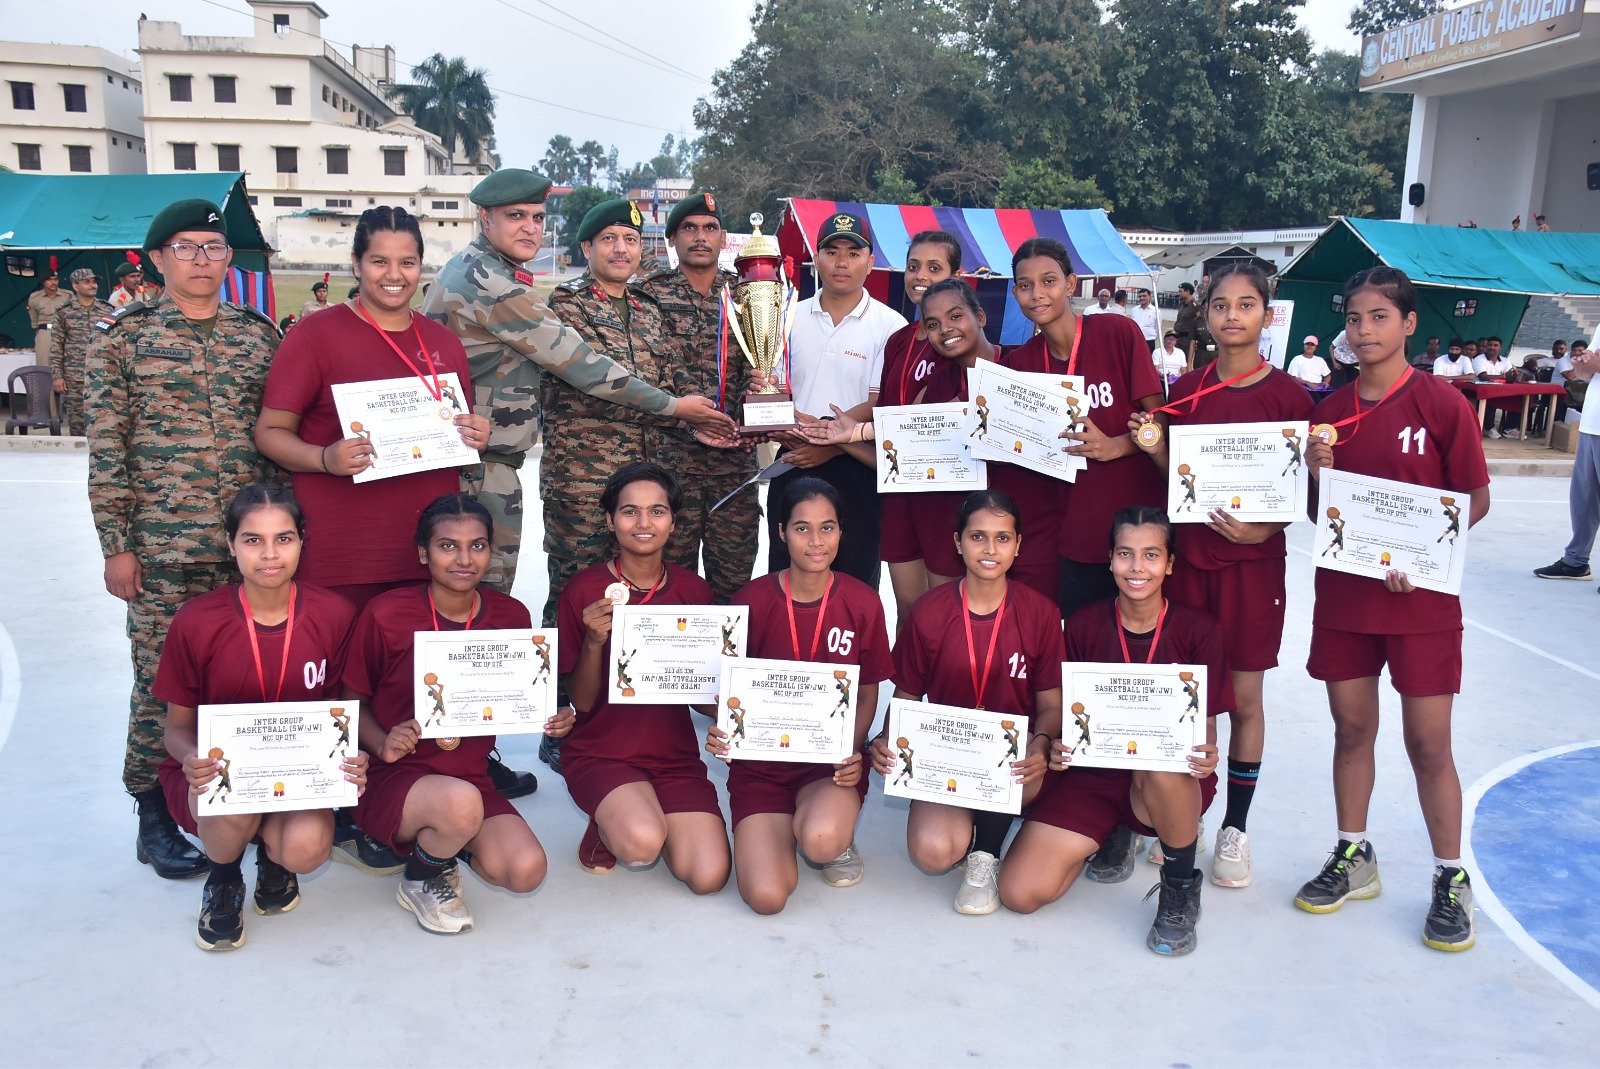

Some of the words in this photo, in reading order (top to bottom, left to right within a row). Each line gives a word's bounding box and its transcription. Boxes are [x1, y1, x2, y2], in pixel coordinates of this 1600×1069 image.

[1380, 17, 1436, 66] CENTRAL
[1440, 1, 1494, 48] PUBLIC
[1407, 59, 1424, 70] Group
[1434, 51, 1457, 63] Leading
[1480, 38, 1501, 52] School
[641, 189, 686, 199] IndanOil
[144, 347, 184, 357] ABRAHAM
[379, 393, 397, 401] INTER
[997, 386, 1032, 404] BASKETBALL
[1010, 384, 1027, 395] INTER
[1028, 390, 1046, 400] GROUP
[1087, 381, 1114, 409] 08
[367, 398, 408, 409] BASKETBALL
[1398, 426, 1426, 455] 11
[1352, 494, 1398, 508] BASKETBALL
[1368, 490, 1389, 500] INTER
[1391, 493, 1414, 504] GROUP
[1386, 508, 1394, 516] UP
[827, 626, 855, 656] 05
[449, 652, 494, 660] BASKETBALL
[1008, 652, 1027, 679] 12
[303, 658, 327, 690] 04
[768, 674, 787, 682] INTER
[752, 681, 795, 690] BASKETBALL
[1095, 685, 1140, 693] BASKETBALL
[254, 718, 277, 726] INTER
[280, 717, 304, 725] GROUP
[935, 718, 955, 727] INTER
[956, 722, 978, 730] GROUP
[236, 725, 288, 734] BASKETBALL
[920, 723, 963, 736] BASKETBALL
[952, 736, 959, 744] UP
